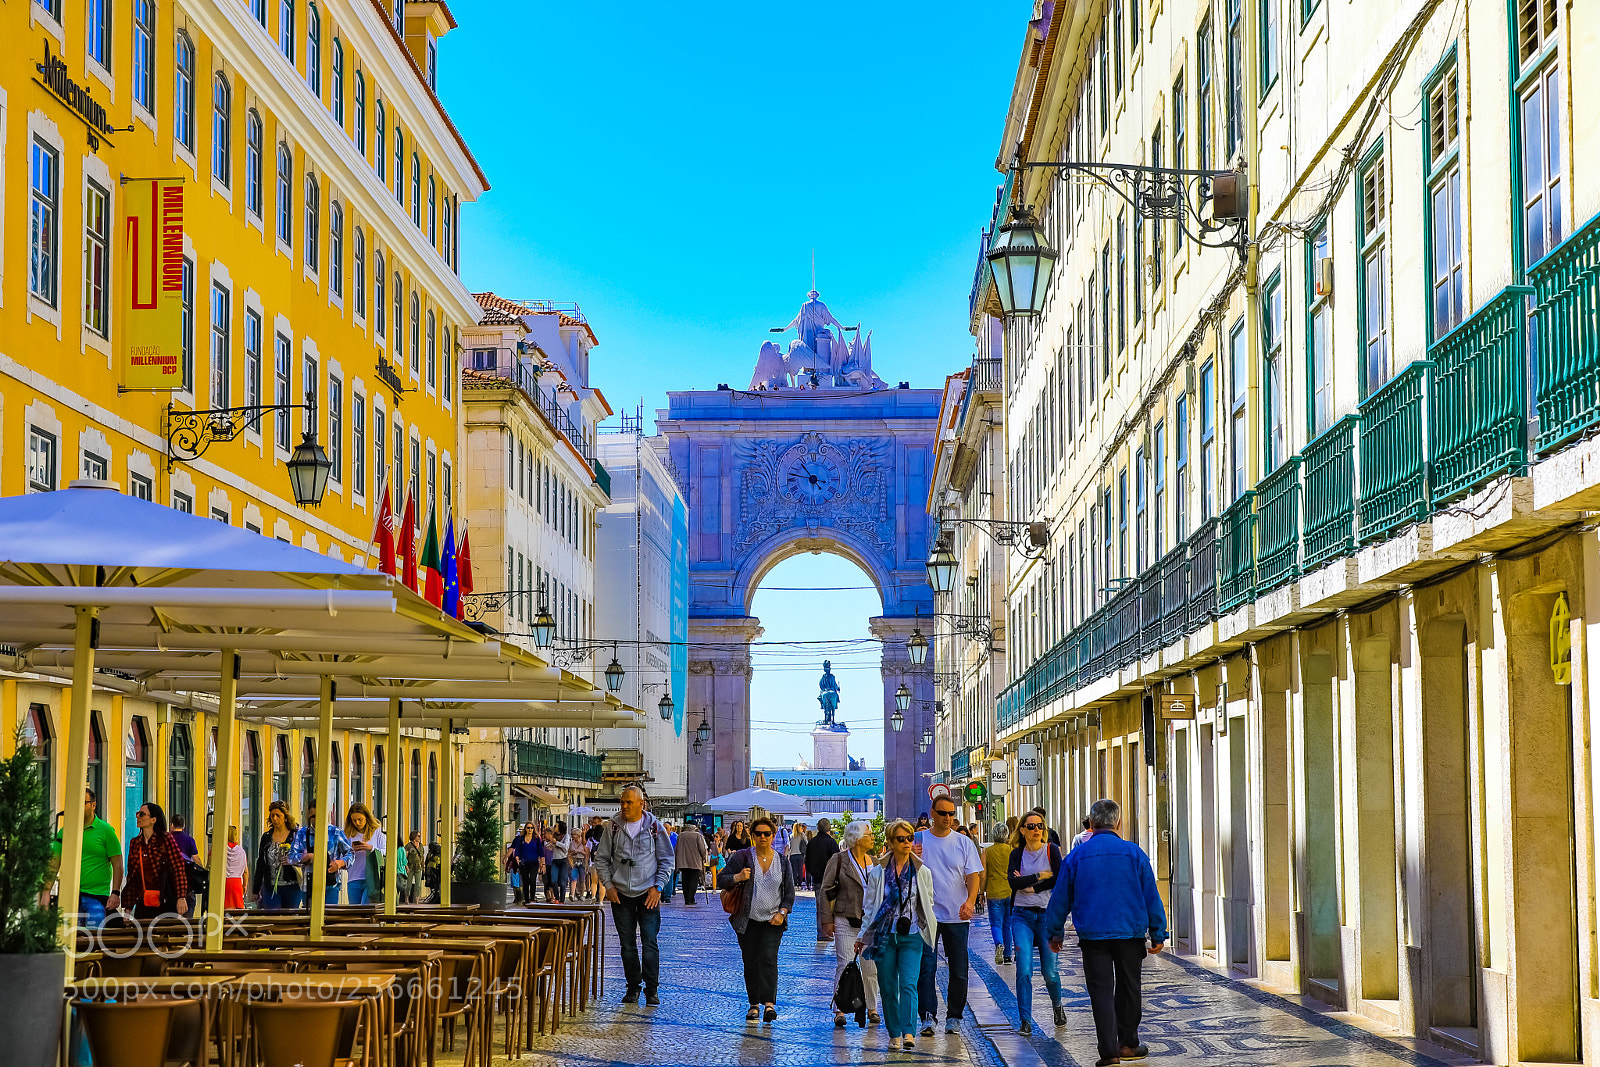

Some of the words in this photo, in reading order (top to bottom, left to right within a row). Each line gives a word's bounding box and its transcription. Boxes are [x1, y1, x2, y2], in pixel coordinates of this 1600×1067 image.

[43, 38, 106, 134] Millennium
[162, 186, 183, 292] MILLENNIUM
[130, 355, 177, 366] MILLENNIUM
[162, 365, 177, 375] BCP
[1020, 758, 1037, 767] P&B
[992, 772, 1007, 780] P&B
[769, 778, 832, 787] EUROVISION
[835, 778, 878, 787] VILLAGE
